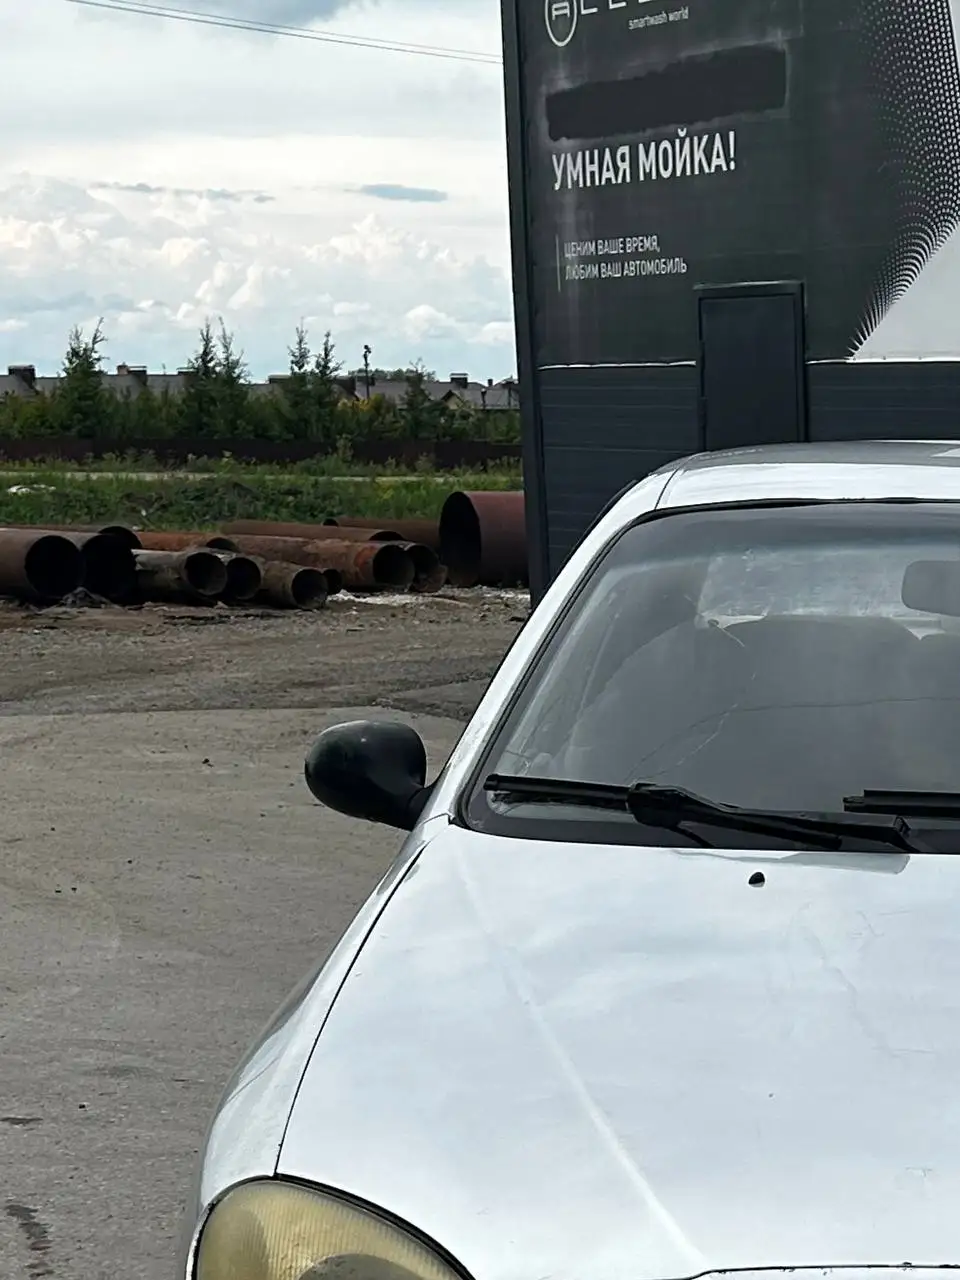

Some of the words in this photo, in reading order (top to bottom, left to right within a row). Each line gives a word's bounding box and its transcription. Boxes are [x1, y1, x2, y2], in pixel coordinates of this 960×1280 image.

[668, 6, 689, 21] world
[552, 145, 631, 190] УМНАЯ
[638, 128, 736, 182] МОЙКА!
[564, 241, 596, 259] ЦЕНИМ
[597, 238, 625, 255] ВАШЕ
[625, 235, 660, 253] ВРЕМЯ,
[565, 263, 599, 280] ЛЮБИМ
[600, 261, 622, 278] ВАШ
[623, 257, 688, 277] АВТОМОБИЛЬ
